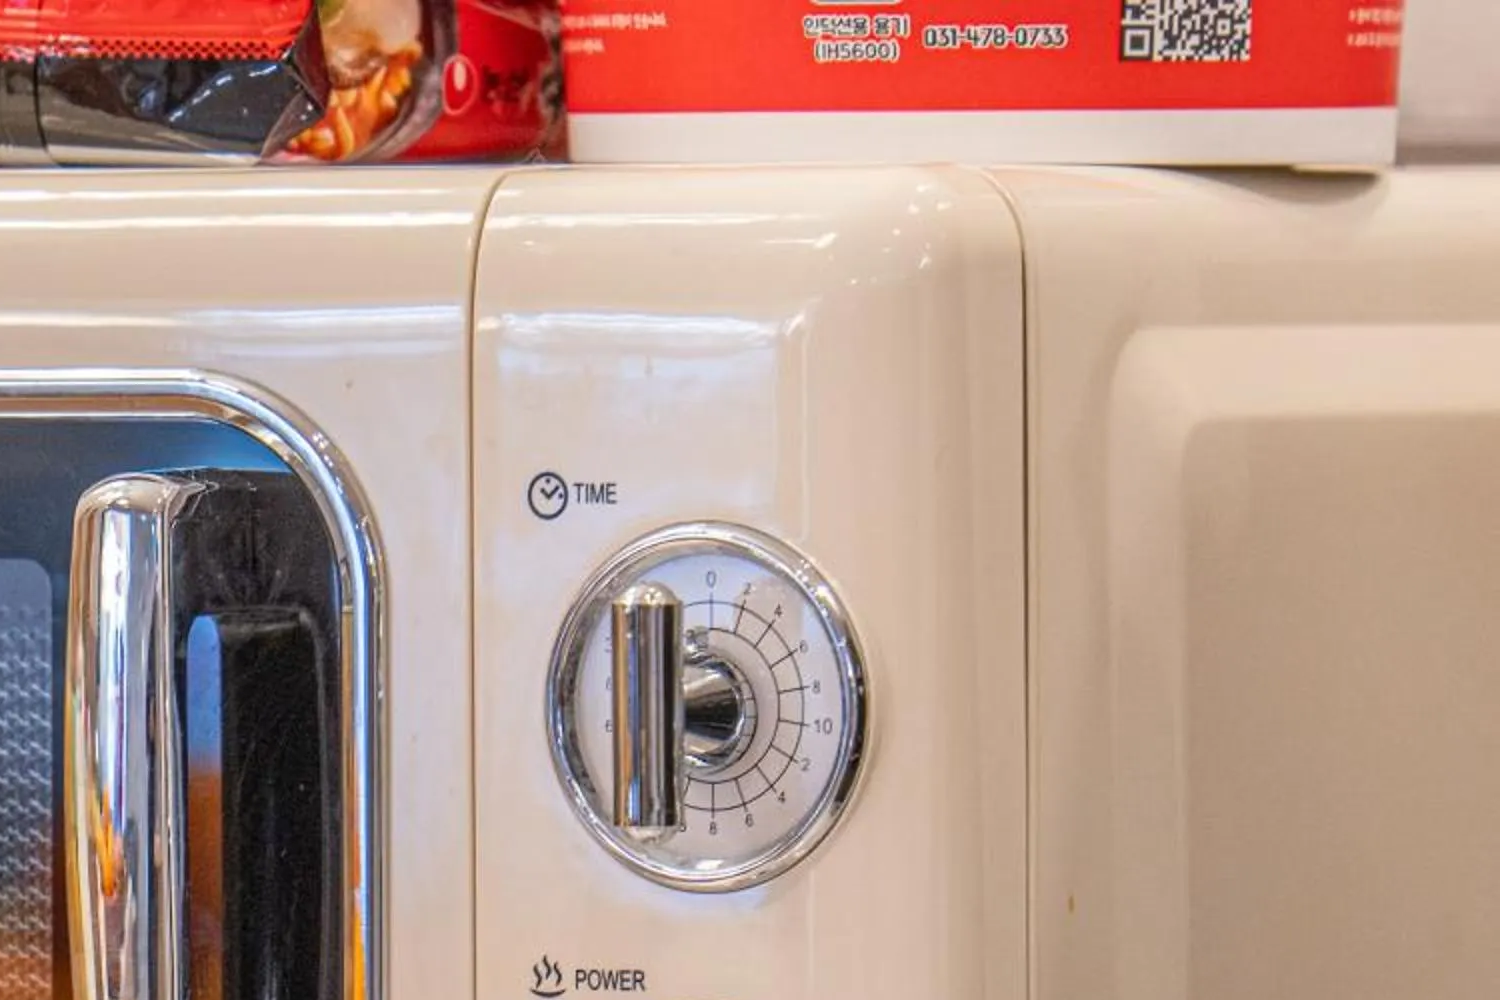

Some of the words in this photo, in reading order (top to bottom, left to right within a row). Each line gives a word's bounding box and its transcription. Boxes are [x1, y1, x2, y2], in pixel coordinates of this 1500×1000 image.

[874, 15, 910, 37] 용기
[923, 26, 1067, 48] 031-478-0733
[815, 41, 899, 61] (IH5600)
[573, 482, 618, 505] TIME
[705, 570, 717, 589] 0
[774, 603, 783, 617] 4
[812, 680, 821, 694] 8
[813, 718, 833, 735] 10
[575, 968, 646, 992] POWER
